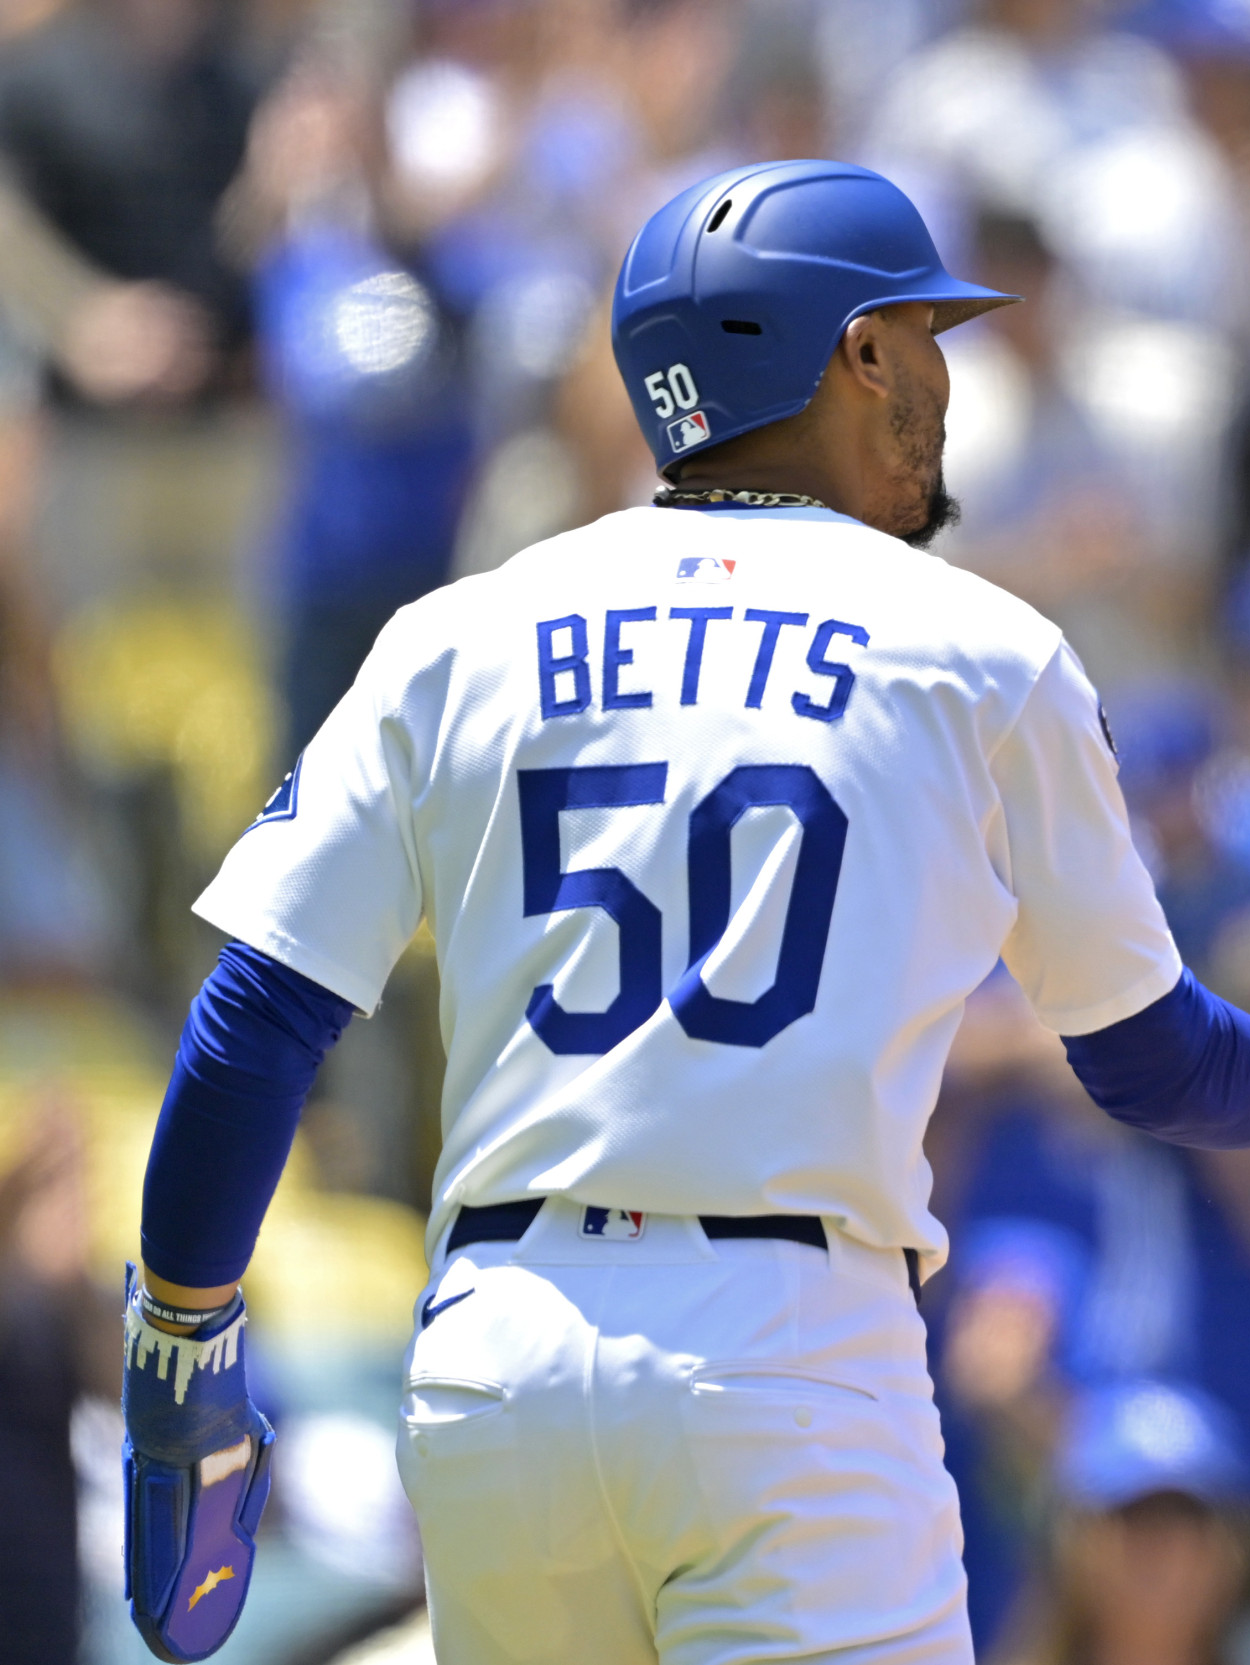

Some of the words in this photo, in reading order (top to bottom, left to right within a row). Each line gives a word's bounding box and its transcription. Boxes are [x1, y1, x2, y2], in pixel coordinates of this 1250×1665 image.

[644, 363, 699, 419] 50
[536, 606, 871, 722] BETTS
[517, 761, 849, 1055] 50
[162, 1309, 174, 1321] ALL
[176, 1313, 201, 1323] THINGS
